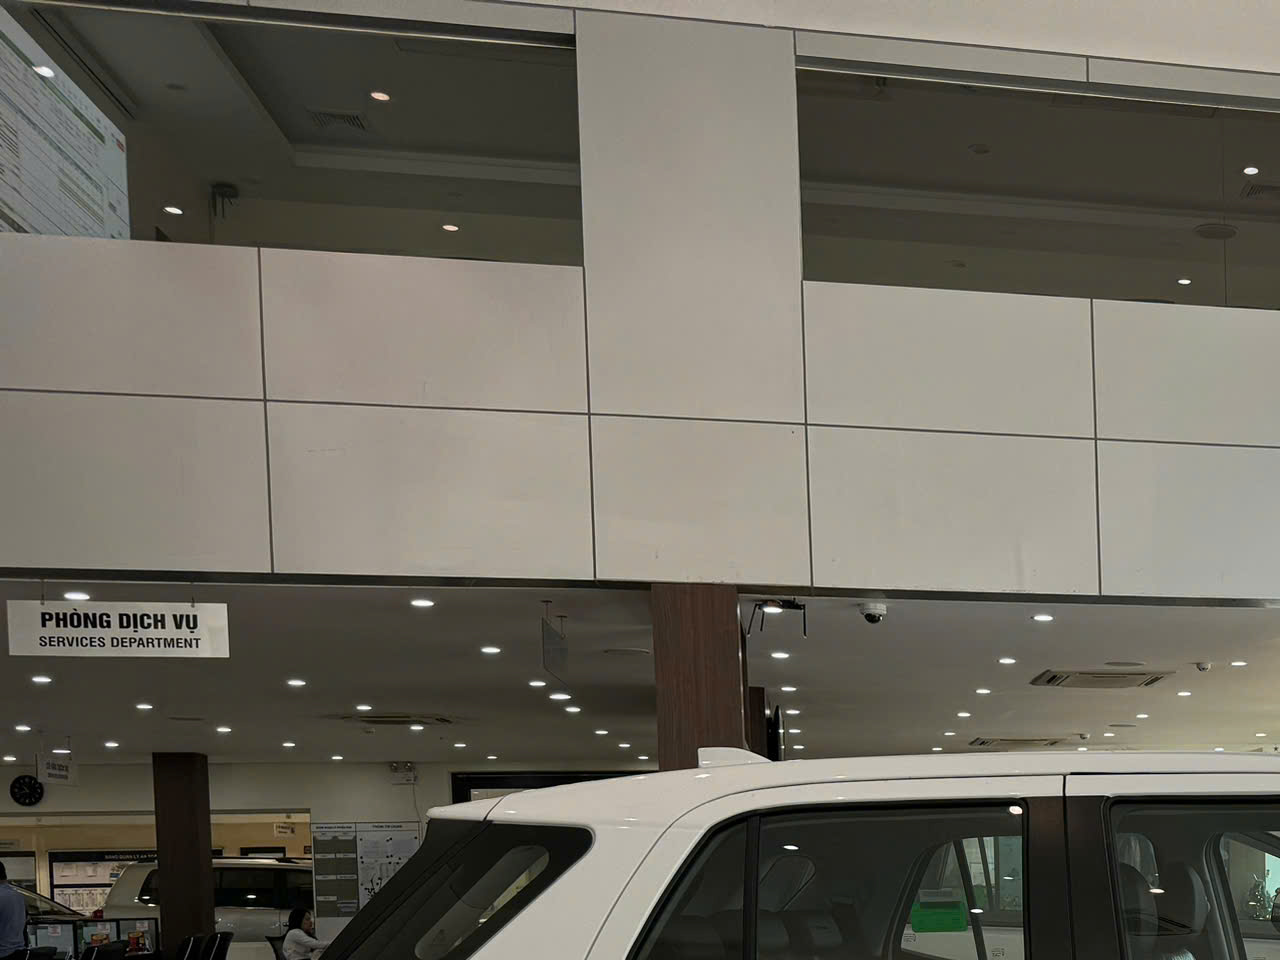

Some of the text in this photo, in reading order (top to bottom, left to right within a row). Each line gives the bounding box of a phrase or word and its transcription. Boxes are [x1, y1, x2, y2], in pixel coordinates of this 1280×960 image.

[40, 608, 199, 634] PHÒNG DỊCH VỤ
[39, 635, 201, 649] SERVICES DEPARTMENT
